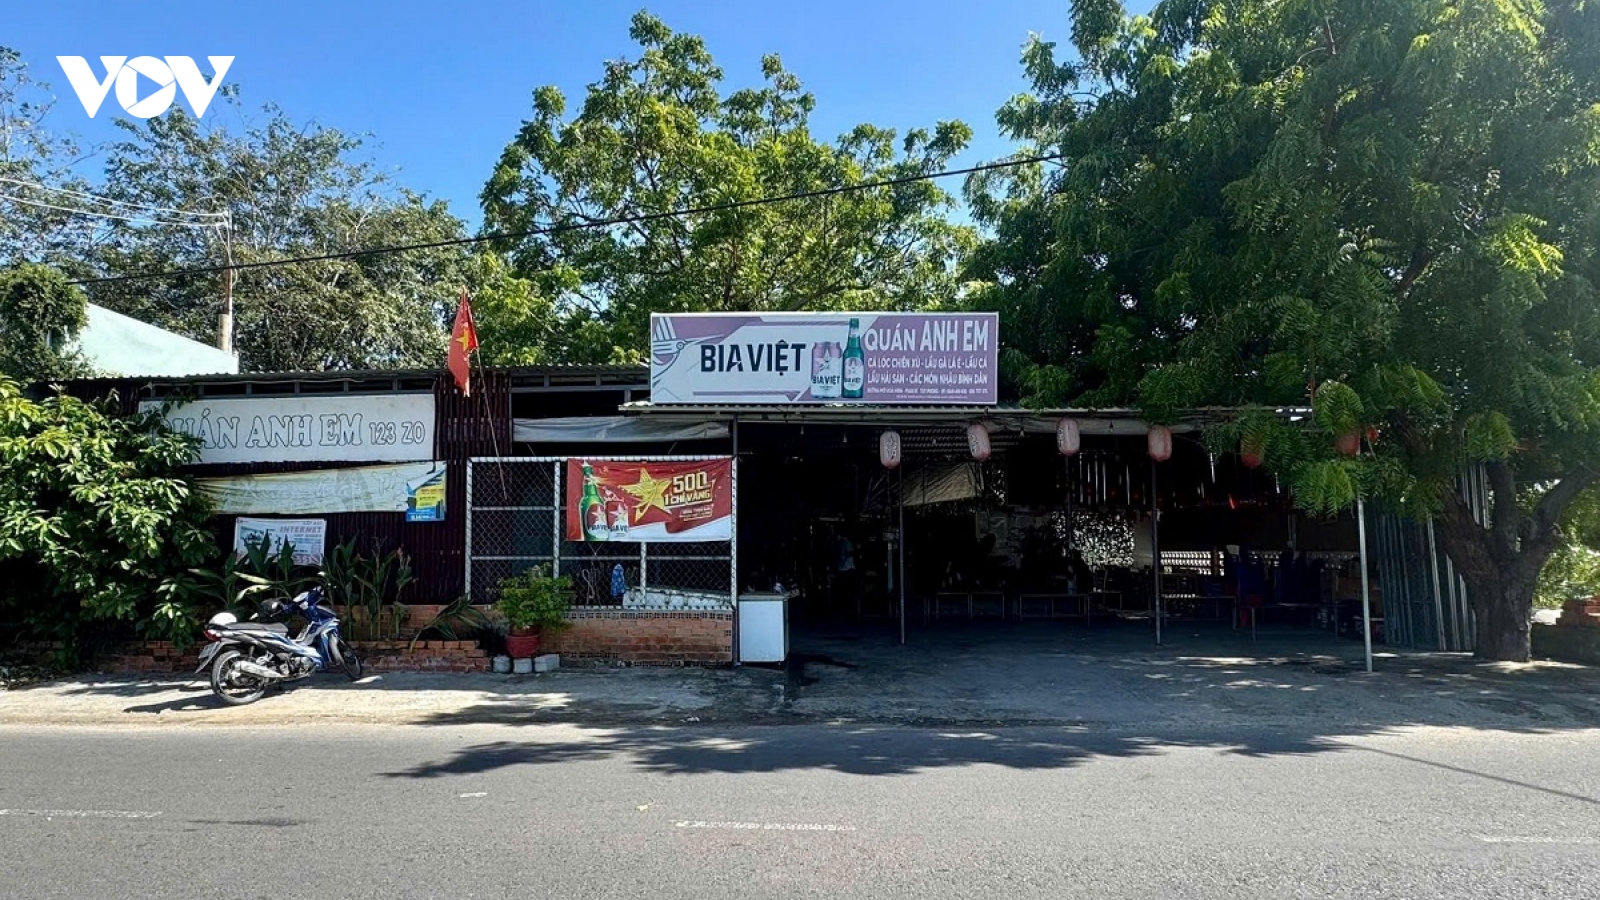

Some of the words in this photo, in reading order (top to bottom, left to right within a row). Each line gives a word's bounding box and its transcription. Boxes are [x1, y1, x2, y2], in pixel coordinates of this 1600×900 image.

[864, 323, 916, 351] QUÁN
[920, 320, 958, 351] ANH
[963, 320, 989, 351] EM
[701, 344, 744, 372] BIA
[747, 339, 807, 376] VIỆT
[245, 415, 313, 448] ANH
[319, 413, 363, 446] EM
[369, 421, 397, 445] 123
[401, 420, 426, 445] ZO
[672, 471, 708, 494] 500
